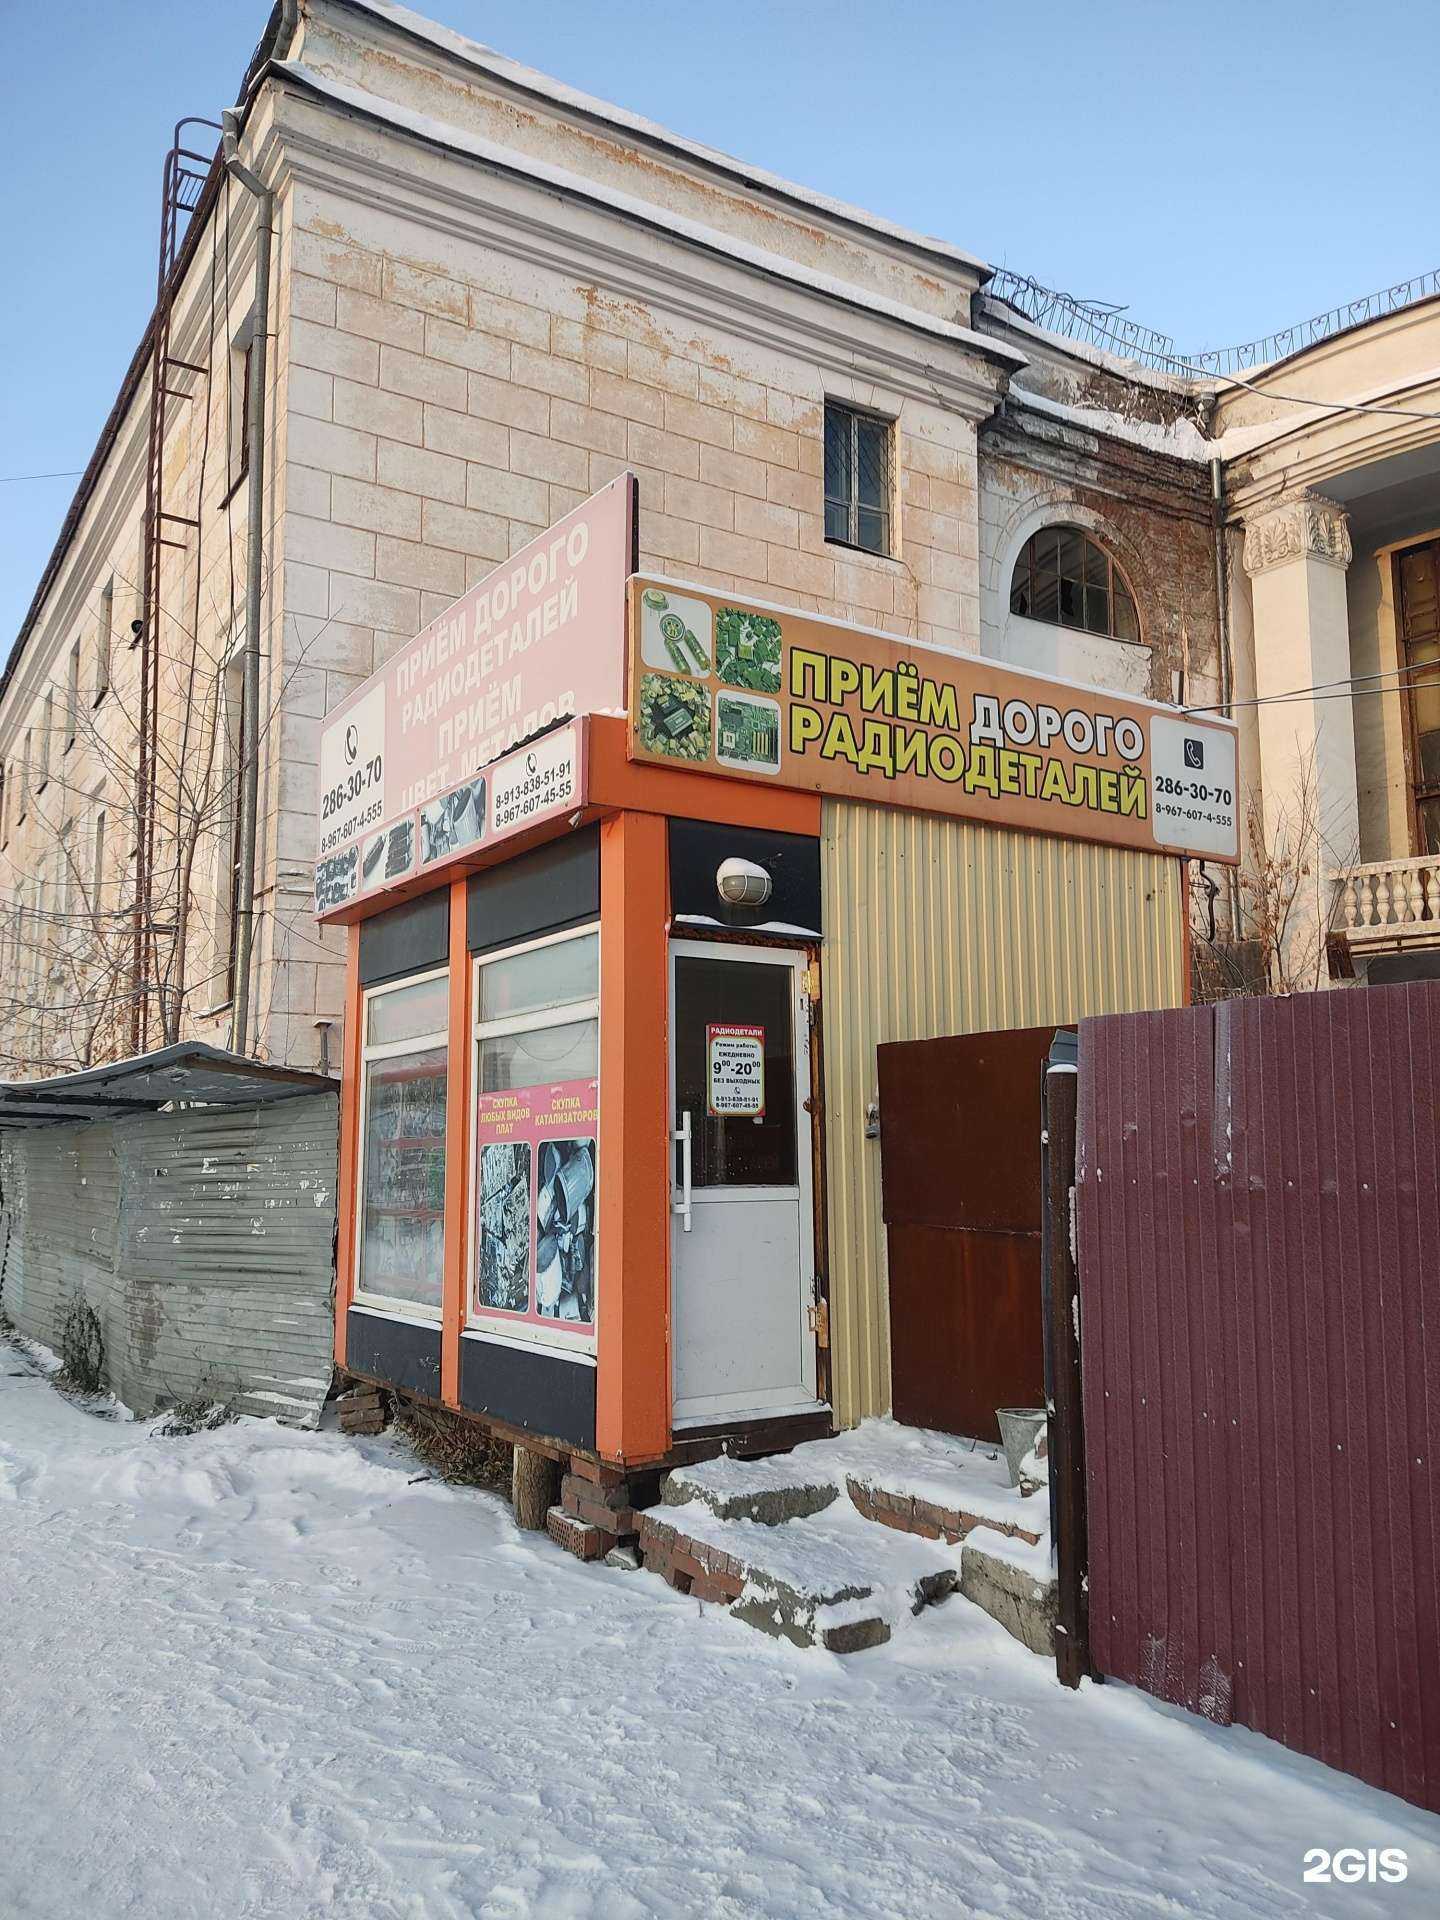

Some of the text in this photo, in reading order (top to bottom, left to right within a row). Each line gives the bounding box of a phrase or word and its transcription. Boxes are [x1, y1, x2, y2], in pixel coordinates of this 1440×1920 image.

[397, 522, 589, 697] ПРИЁМ ДОРОГО
[402, 576, 578, 734] РАДИОДЕТАЛЕЙ
[439, 672, 522, 761] ПРИЁМ
[790, 646, 1145, 762] ПРИЁМ ДОРОГО
[496, 760, 571, 809] 8-913-838-51-91
[790, 702, 1148, 820] РАДИОДЕТАЛЕЙ
[322, 755, 381, 820] 286-30-70
[495, 780, 572, 828] 8-967-607-45-55
[1155, 776, 1232, 806] 286-30-70
[321, 800, 382, 853] 8-967-607-4-555
[1155, 803, 1232, 827] 8-967-607-4-555
[711, 1027, 763, 1036] РАДИОДЕТАЛИ
[480, 1108, 530, 1124] ЛЮБЫХ ВИДОВ
[493, 1097, 518, 1109] СКУПКА
[552, 1097, 581, 1110] СКУПКА
[496, 1123, 513, 1134] ПЛАТ
